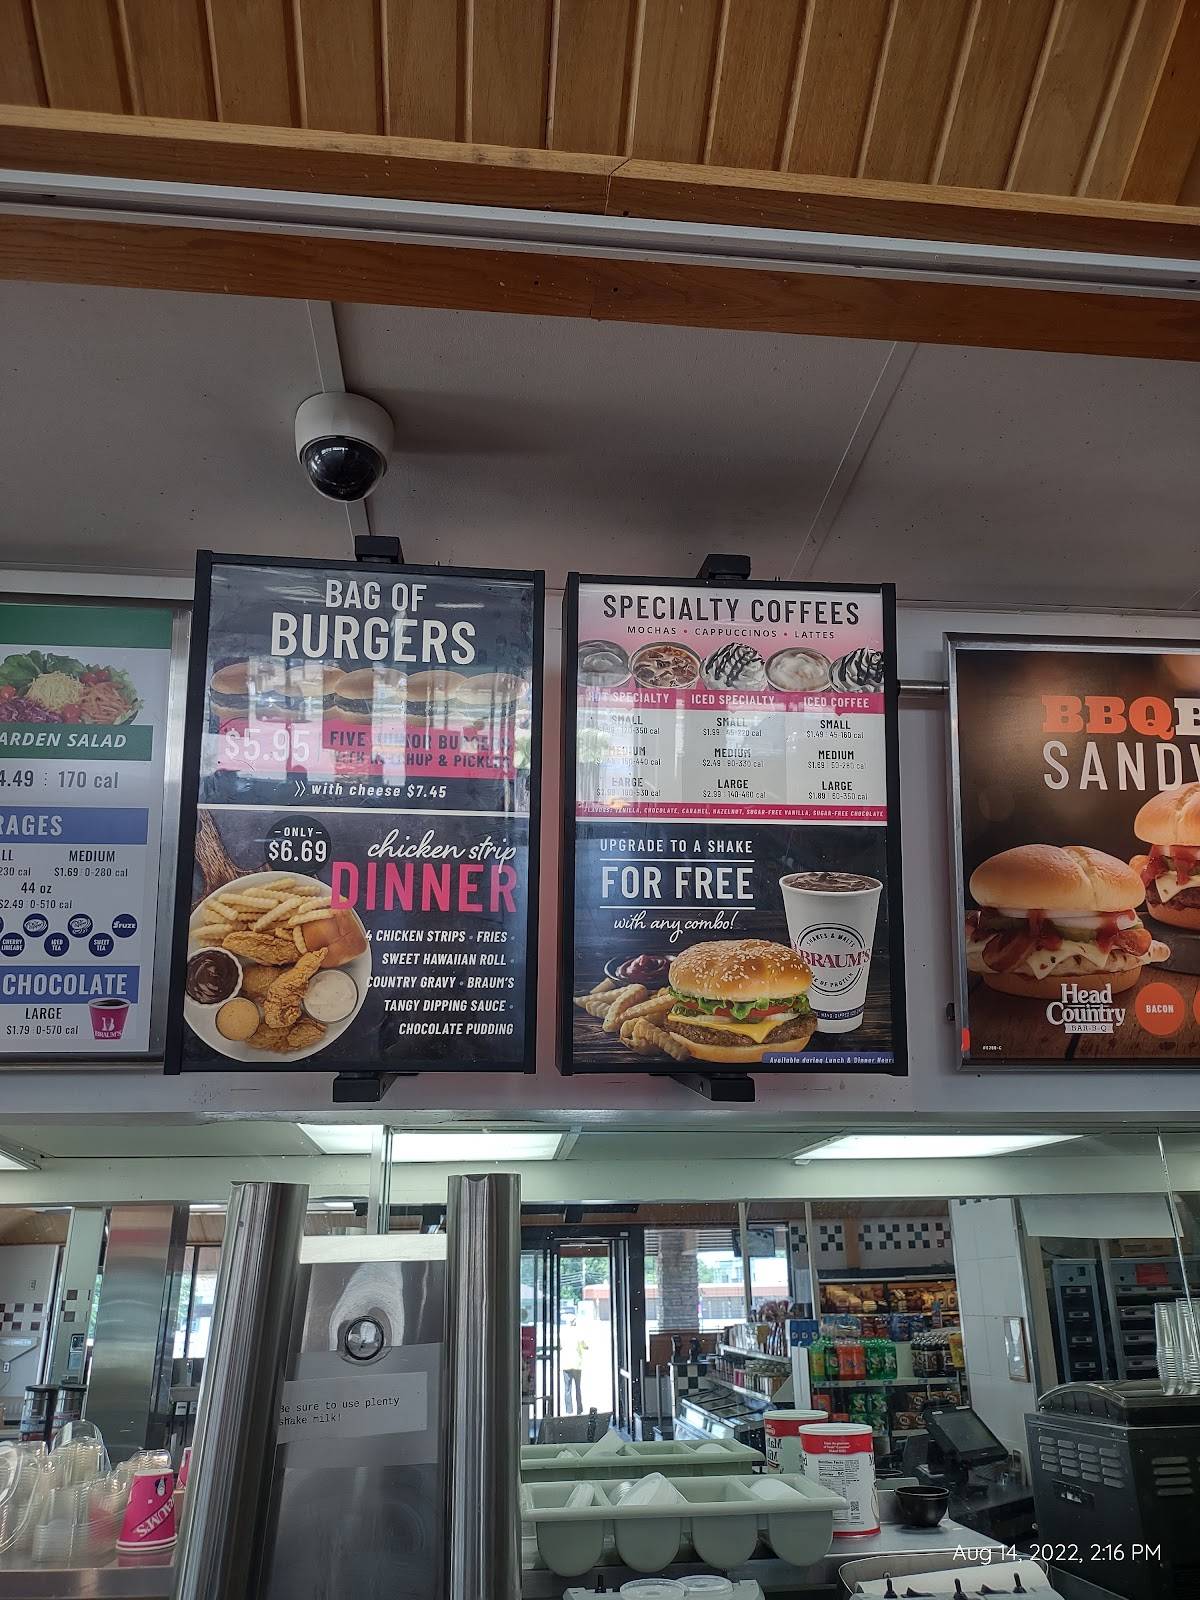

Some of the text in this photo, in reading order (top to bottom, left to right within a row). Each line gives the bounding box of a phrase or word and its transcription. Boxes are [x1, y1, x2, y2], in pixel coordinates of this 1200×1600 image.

[325, 579, 428, 612] BAG OF
[603, 594, 860, 626] SPECIALTY COFFEES
[627, 626, 835, 639] MOCHAS CAPPUCCINOS LATTES
[270, 613, 476, 665] BURGERS
[613, 692, 670, 704] SPECIALTY
[691, 694, 775, 705] ICED SPECIALTY
[803, 696, 870, 708] ICED COFFEE
[611, 715, 643, 725] SMALL
[716, 717, 748, 727] SMALL
[820, 719, 851, 729] SMALL
[649, 727, 660, 735] cal
[751, 729, 762, 737] cal
[853, 731, 864, 739] cal
[67, 733, 127, 748] SALAD
[224, 727, 310, 762] $5.95
[329, 730, 366, 748] FIVE
[714, 748, 751, 758] MEDIUM
[818, 750, 855, 760] MEDIUM
[650, 758, 661, 766] cal
[753, 760, 764, 768] cal
[58, 771, 87, 788] 170
[93, 772, 119, 788] cal
[717, 779, 749, 789] LARGE
[311, 783, 447, 799] with cheese $7.45
[821, 781, 853, 791] LARGE
[650, 789, 661, 797] cal
[857, 793, 868, 801] cal
[267, 839, 328, 863] $6.69
[367, 828, 517, 874] chicken strip
[600, 839, 753, 853] UPGRADE TO A SHAKE
[68, 850, 116, 862] MEDIUM
[18, 867, 31, 876] cal
[54, 867, 79, 877] $1.69
[115, 868, 128, 877] cal
[20, 882, 52, 894] 44 oz
[330, 861, 518, 912] DINNER
[602, 866, 754, 900] FOR FREE
[30, 900, 56, 909] 0-510
[59, 900, 73, 909] cal
[614, 910, 740, 943] with any combo!
[376, 930, 424, 942] CHICKEN
[426, 930, 466, 943] STRIPS
[476, 931, 508, 943] FRIES
[382, 953, 507, 966] SWEET HAWAIIAN ROLL
[799, 948, 871, 969] BRAUM'S
[2, 973, 128, 995] CHOCOLATE
[367, 976, 515, 989] COUNTRY GRAVY BRAUM'S
[1060, 983, 1112, 1004] Head
[384, 999, 506, 1012] TANGY DIPPING SAUCE
[1145, 1004, 1174, 1013] BACON
[25, 1007, 63, 1019] LARGE
[1045, 1001, 1126, 1026] Country
[6, 1025, 79, 1035] $1.79 0-570 cal
[399, 1023, 514, 1036] CHOCOLATE PUDDING
[296, 1402, 319, 1412] sure
[326, 1401, 337, 1410] to
[342, 1399, 360, 1408] use
[365, 1397, 400, 1409] plenty
[279, 1415, 307, 1426] shake
